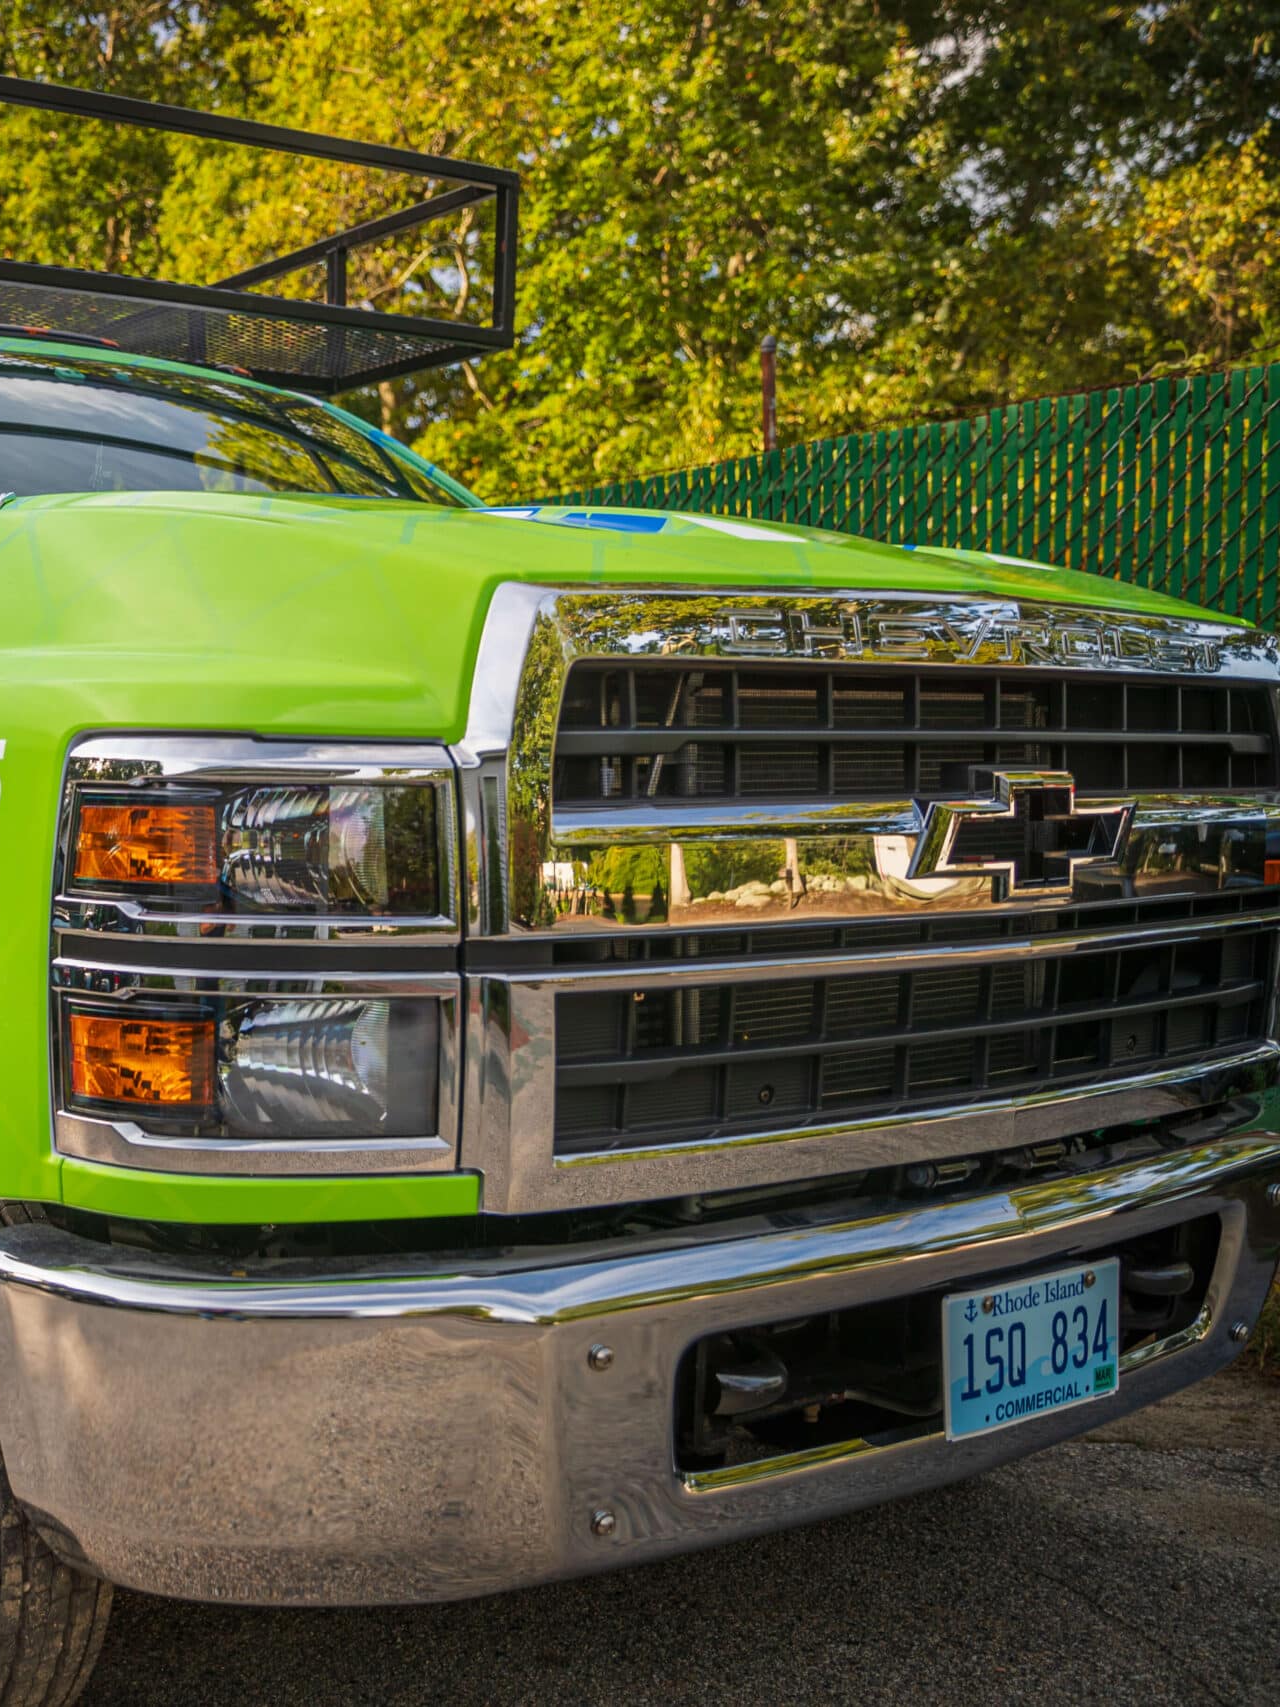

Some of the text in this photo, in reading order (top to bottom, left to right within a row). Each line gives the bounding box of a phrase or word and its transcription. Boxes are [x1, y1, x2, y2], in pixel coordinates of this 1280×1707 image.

[720, 607, 1221, 672] CHEVROLET
[992, 1273, 1085, 1317] Rhode Island
[960, 1299, 1108, 1401] 1SQ 834
[995, 1382, 1082, 1421] COMMERCIAL
